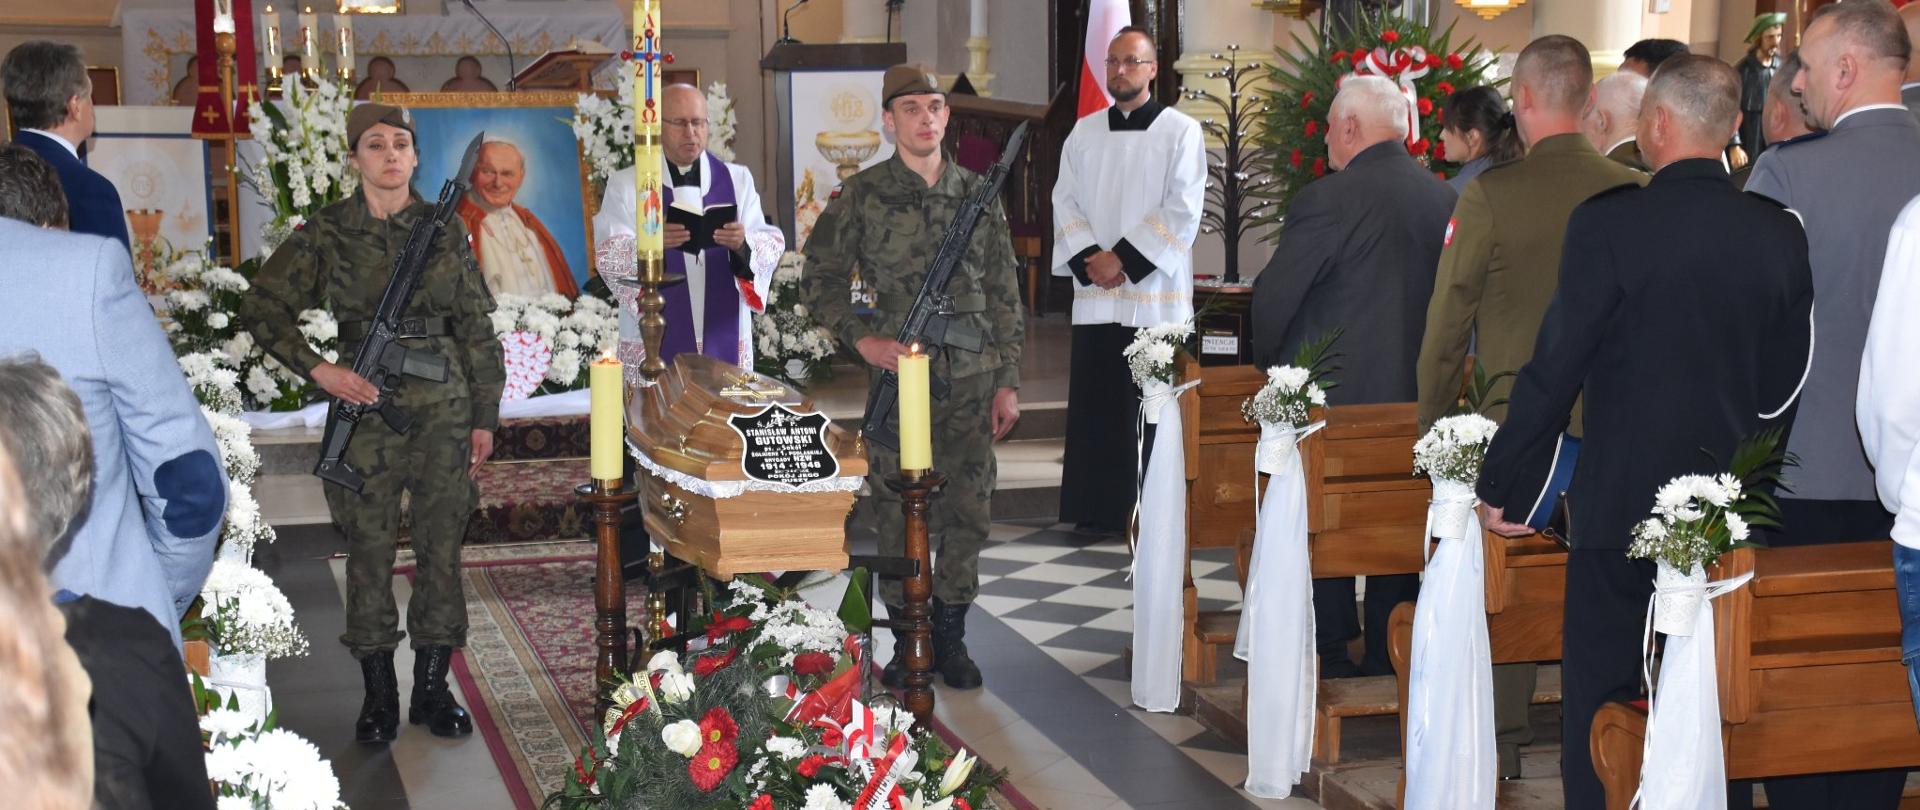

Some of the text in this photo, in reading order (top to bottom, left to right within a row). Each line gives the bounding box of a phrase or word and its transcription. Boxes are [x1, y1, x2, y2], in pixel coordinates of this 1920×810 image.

[746, 427, 817, 437] STANISŁAW ANTONI
[755, 435, 813, 446] GUTOWSKI
